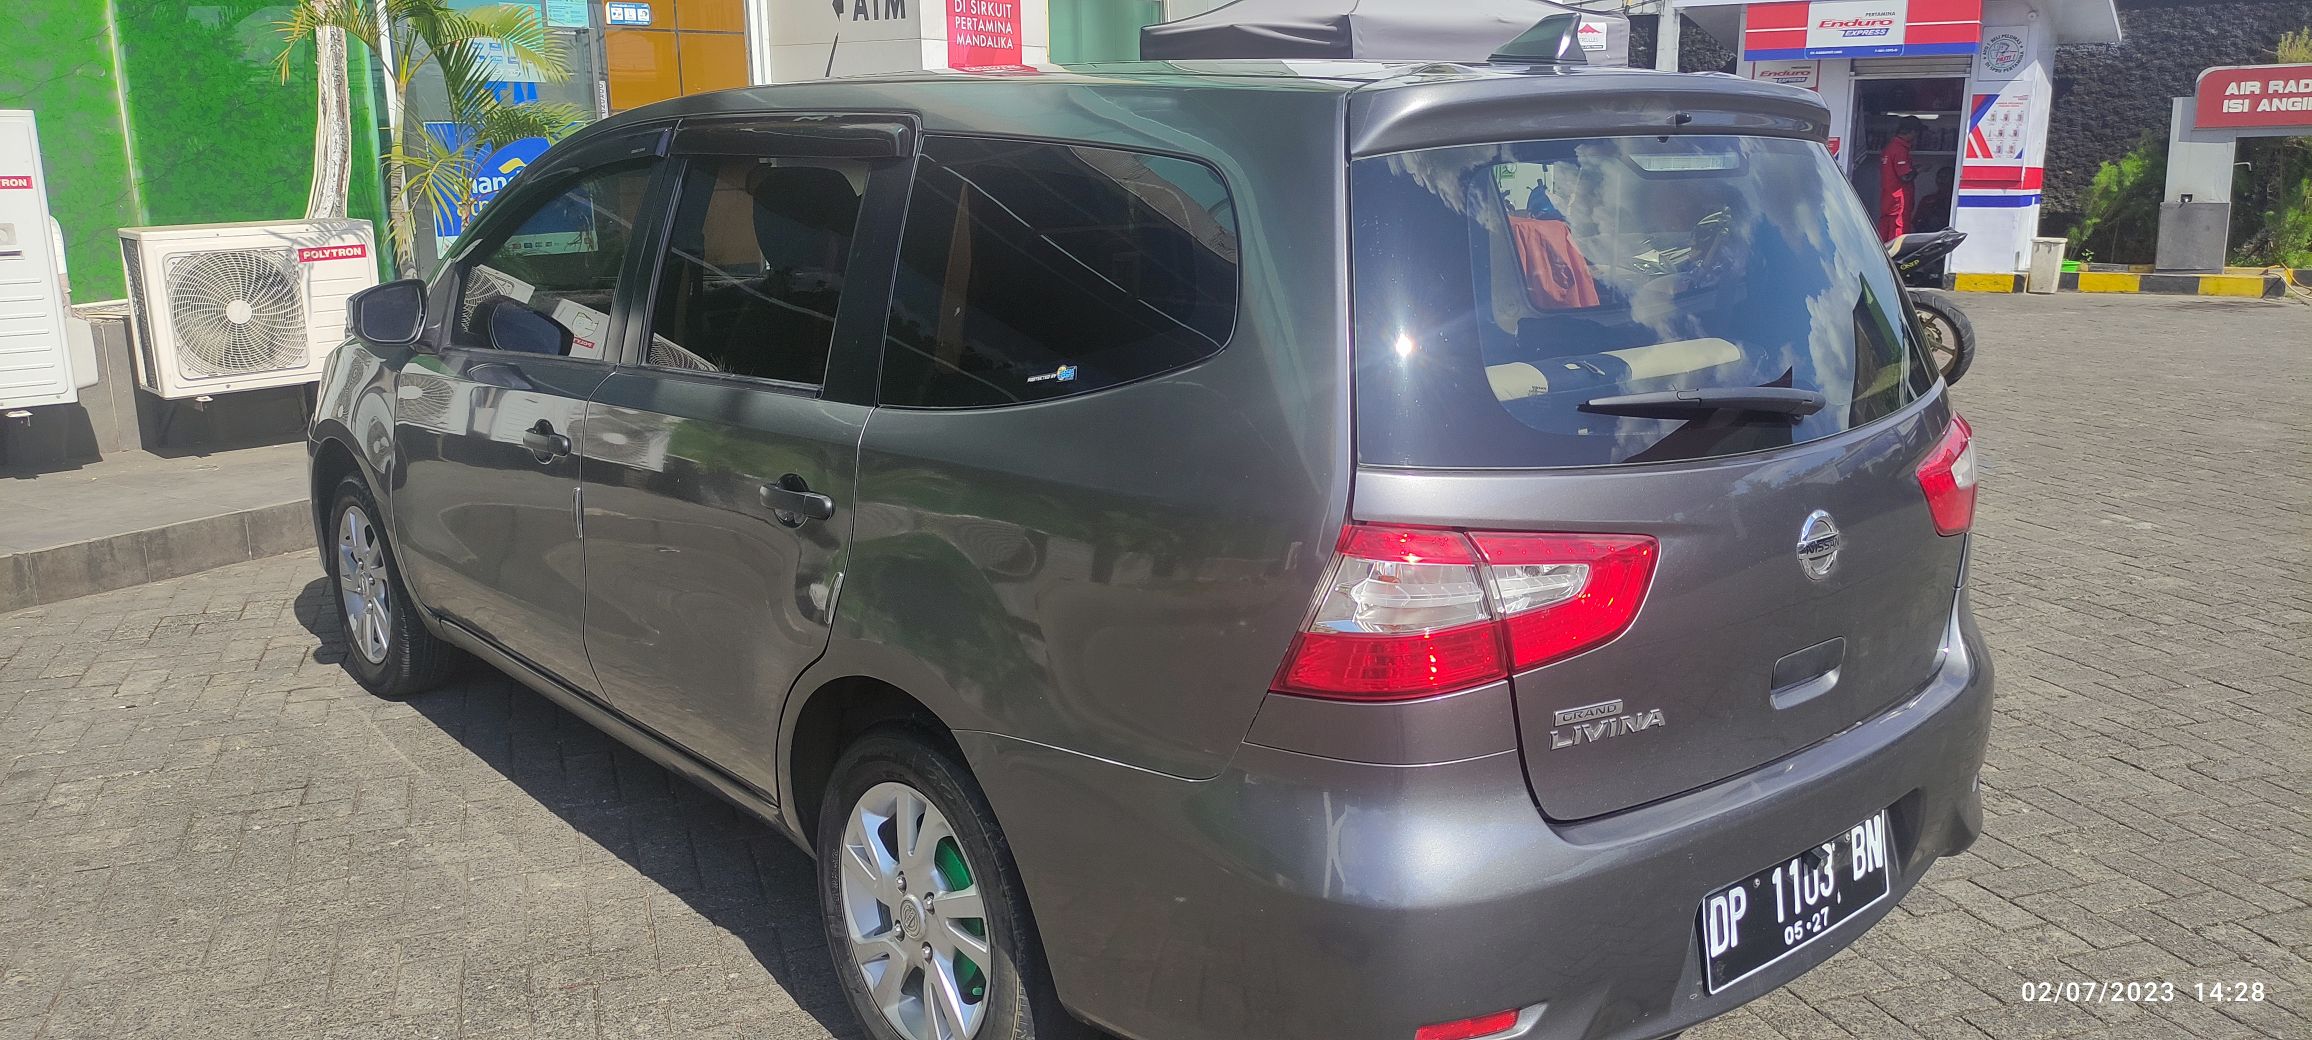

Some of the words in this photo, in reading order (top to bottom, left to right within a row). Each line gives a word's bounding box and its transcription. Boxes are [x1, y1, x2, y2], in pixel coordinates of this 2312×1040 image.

[954, 0, 966, 13] DI
[970, 0, 1012, 19] SIRKUIT
[955, 16, 1013, 35] PERTAMINA
[1818, 18, 1894, 28] Enduro
[956, 33, 1014, 50] MANDALIKA
[2224, 81, 2260, 96] AIR
[2267, 79, 2312, 94] RAD
[2222, 99, 2250, 113] ISI
[0, 178, 28, 187] RON
[303, 247, 362, 259] POLYTRON
[1806, 537, 1840, 555] NISSAN
[1563, 704, 1617, 722] GRAND
[1549, 708, 1666, 751] LIVINA
[1710, 886, 1747, 958] DP
[1851, 815, 1883, 881] BN
